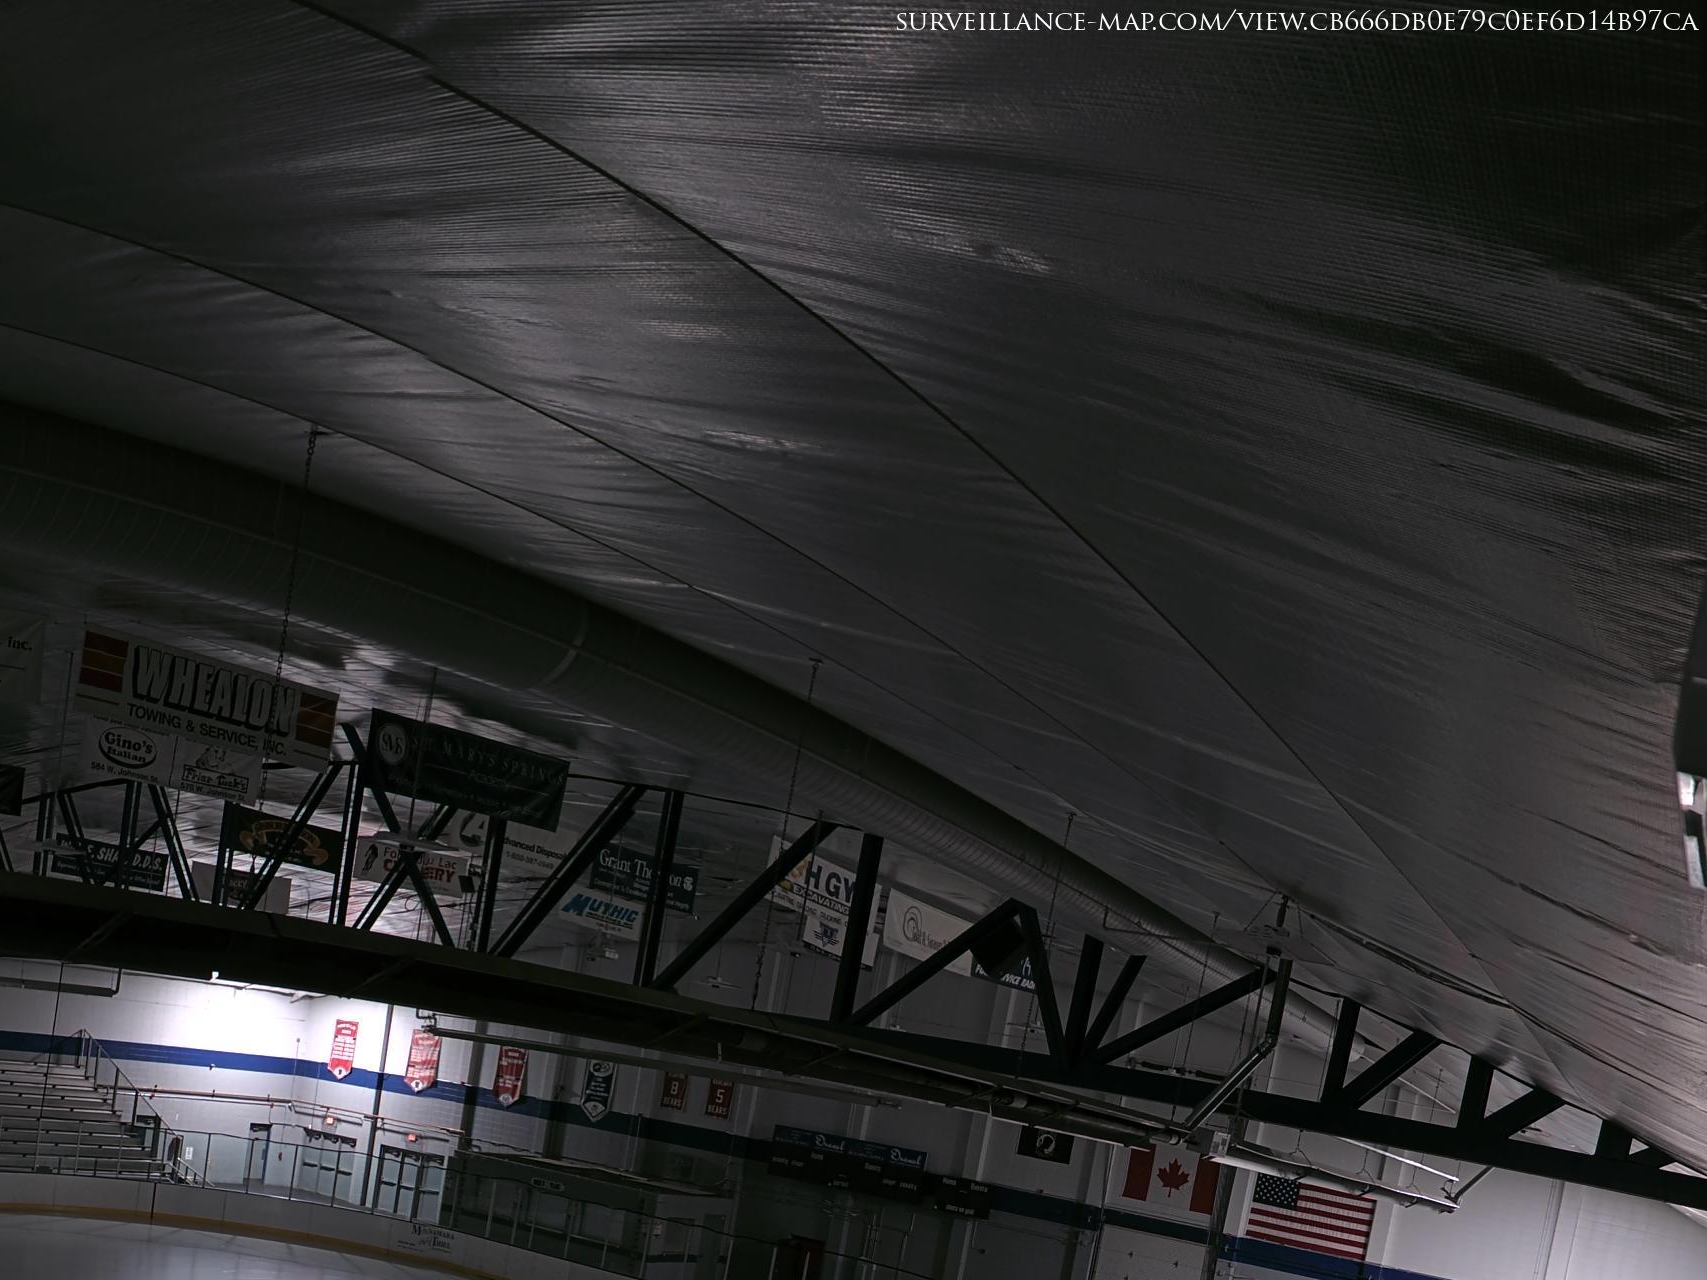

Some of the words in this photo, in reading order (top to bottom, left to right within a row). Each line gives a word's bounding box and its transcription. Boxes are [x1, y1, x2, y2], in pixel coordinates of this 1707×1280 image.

[132, 645, 296, 737] WHEALON
[127, 703, 182, 731] TOWING
[186, 720, 195, 731] &
[200, 723, 258, 749] SERVICE,
[105, 731, 154, 754] Gino's
[107, 746, 147, 764] Italian
[599, 848, 631, 873] Grant
